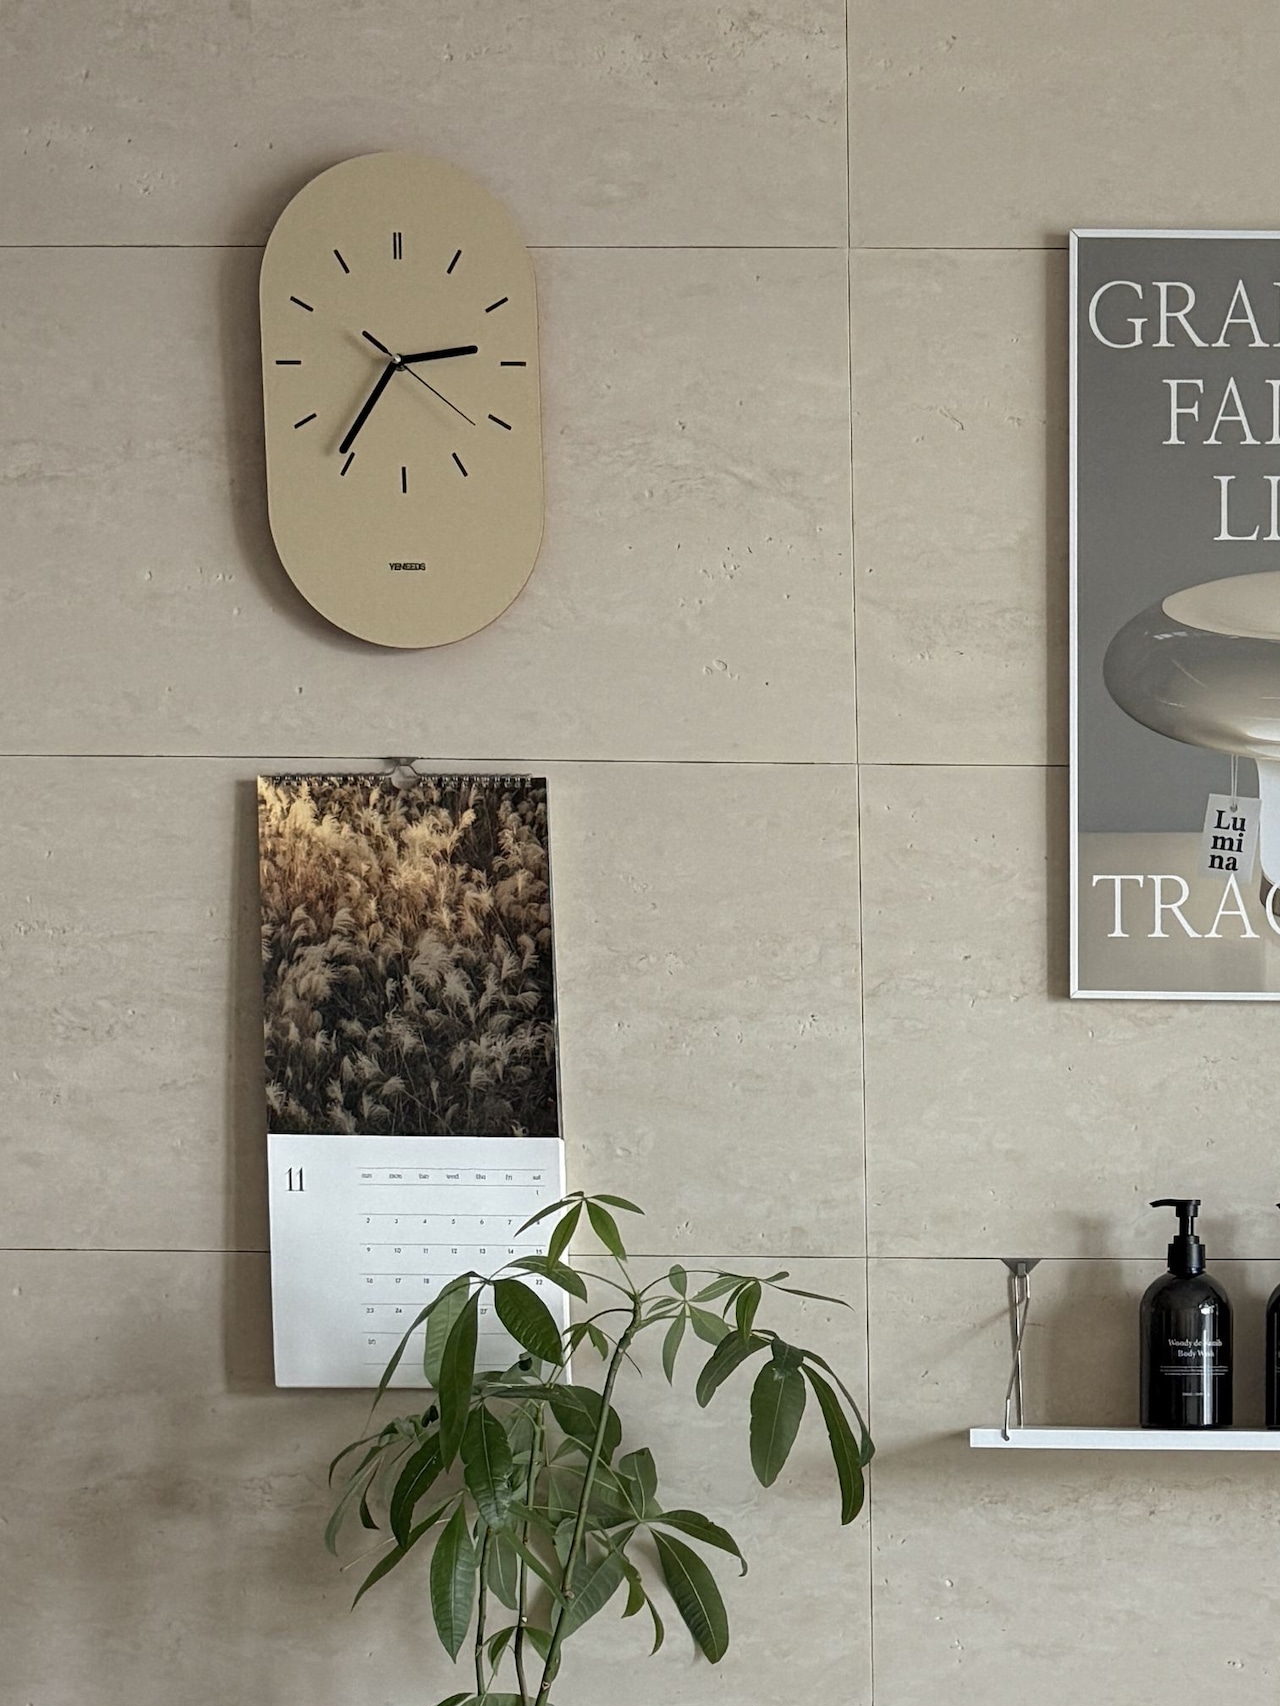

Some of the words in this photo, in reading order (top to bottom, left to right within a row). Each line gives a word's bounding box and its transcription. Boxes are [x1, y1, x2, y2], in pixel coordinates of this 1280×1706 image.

[1213, 809, 1246, 832] Lu
[1210, 832, 1244, 853] mi
[1208, 854, 1239, 872] na
[285, 1166, 305, 1191] 11
[1168, 1338, 1193, 1349] Woody
[1177, 1349, 1196, 1359] Body
